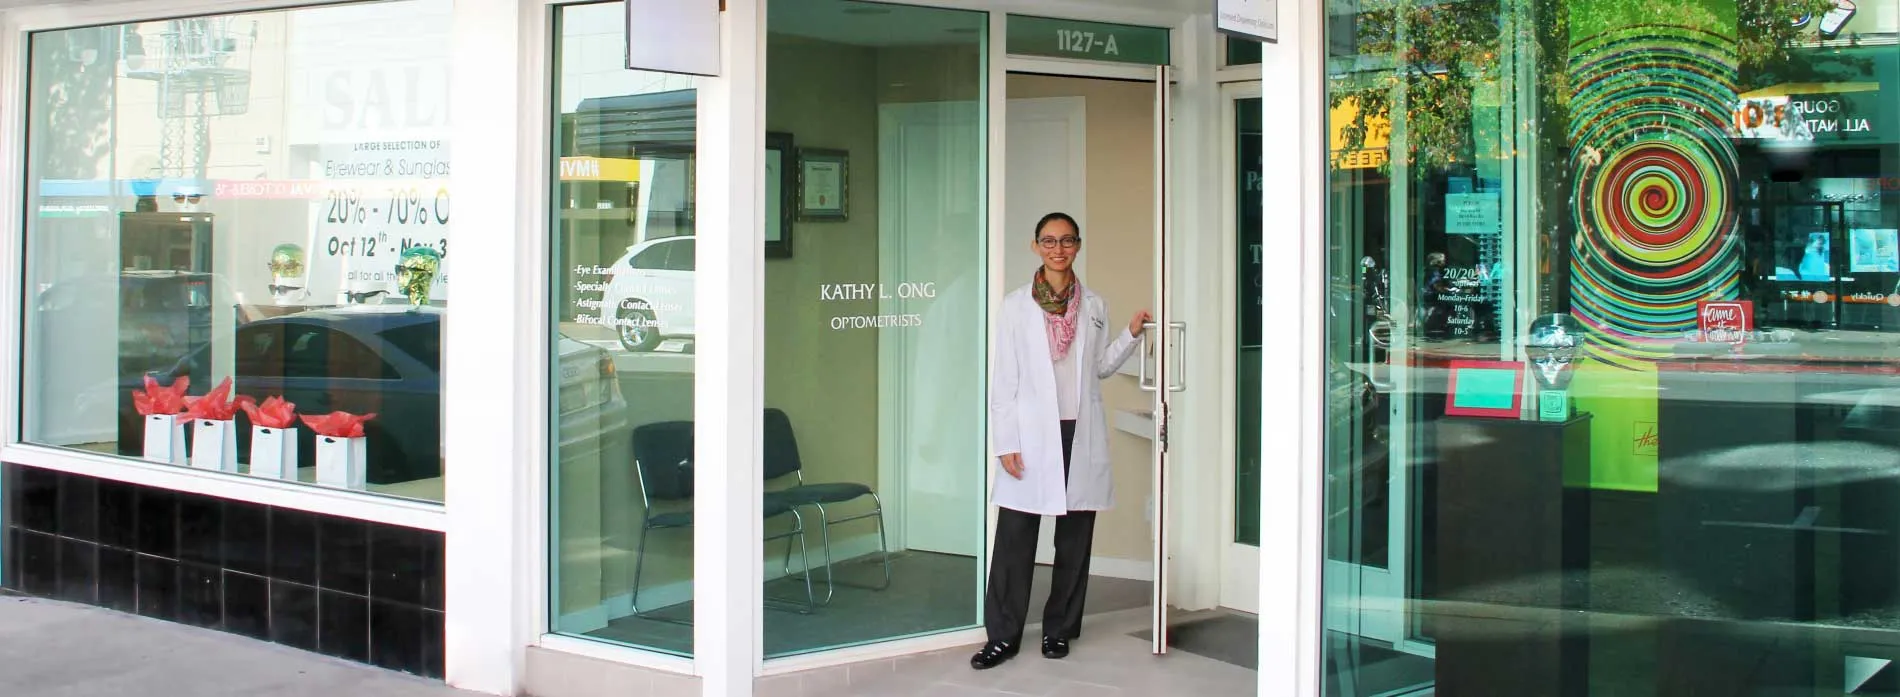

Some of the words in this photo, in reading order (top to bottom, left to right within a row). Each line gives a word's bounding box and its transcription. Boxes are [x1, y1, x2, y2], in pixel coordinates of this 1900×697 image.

[1057, 29, 1119, 55] 1127-A
[354, 142, 380, 152] LARGE
[383, 140, 427, 151] SELECTION
[429, 140, 441, 150] OF
[325, 160, 380, 179] Eyewear
[384, 158, 394, 176] &
[327, 189, 366, 225] 20%
[385, 188, 428, 225] 70%
[328, 237, 355, 256] Oct
[1443, 267, 1475, 280] 20/20
[820, 283, 875, 300] KATHY
[879, 283, 893, 299] L.
[897, 282, 936, 299] ONG
[830, 313, 922, 330] OPTOMETRISTS
[1446, 316, 1475, 326] Saturday
